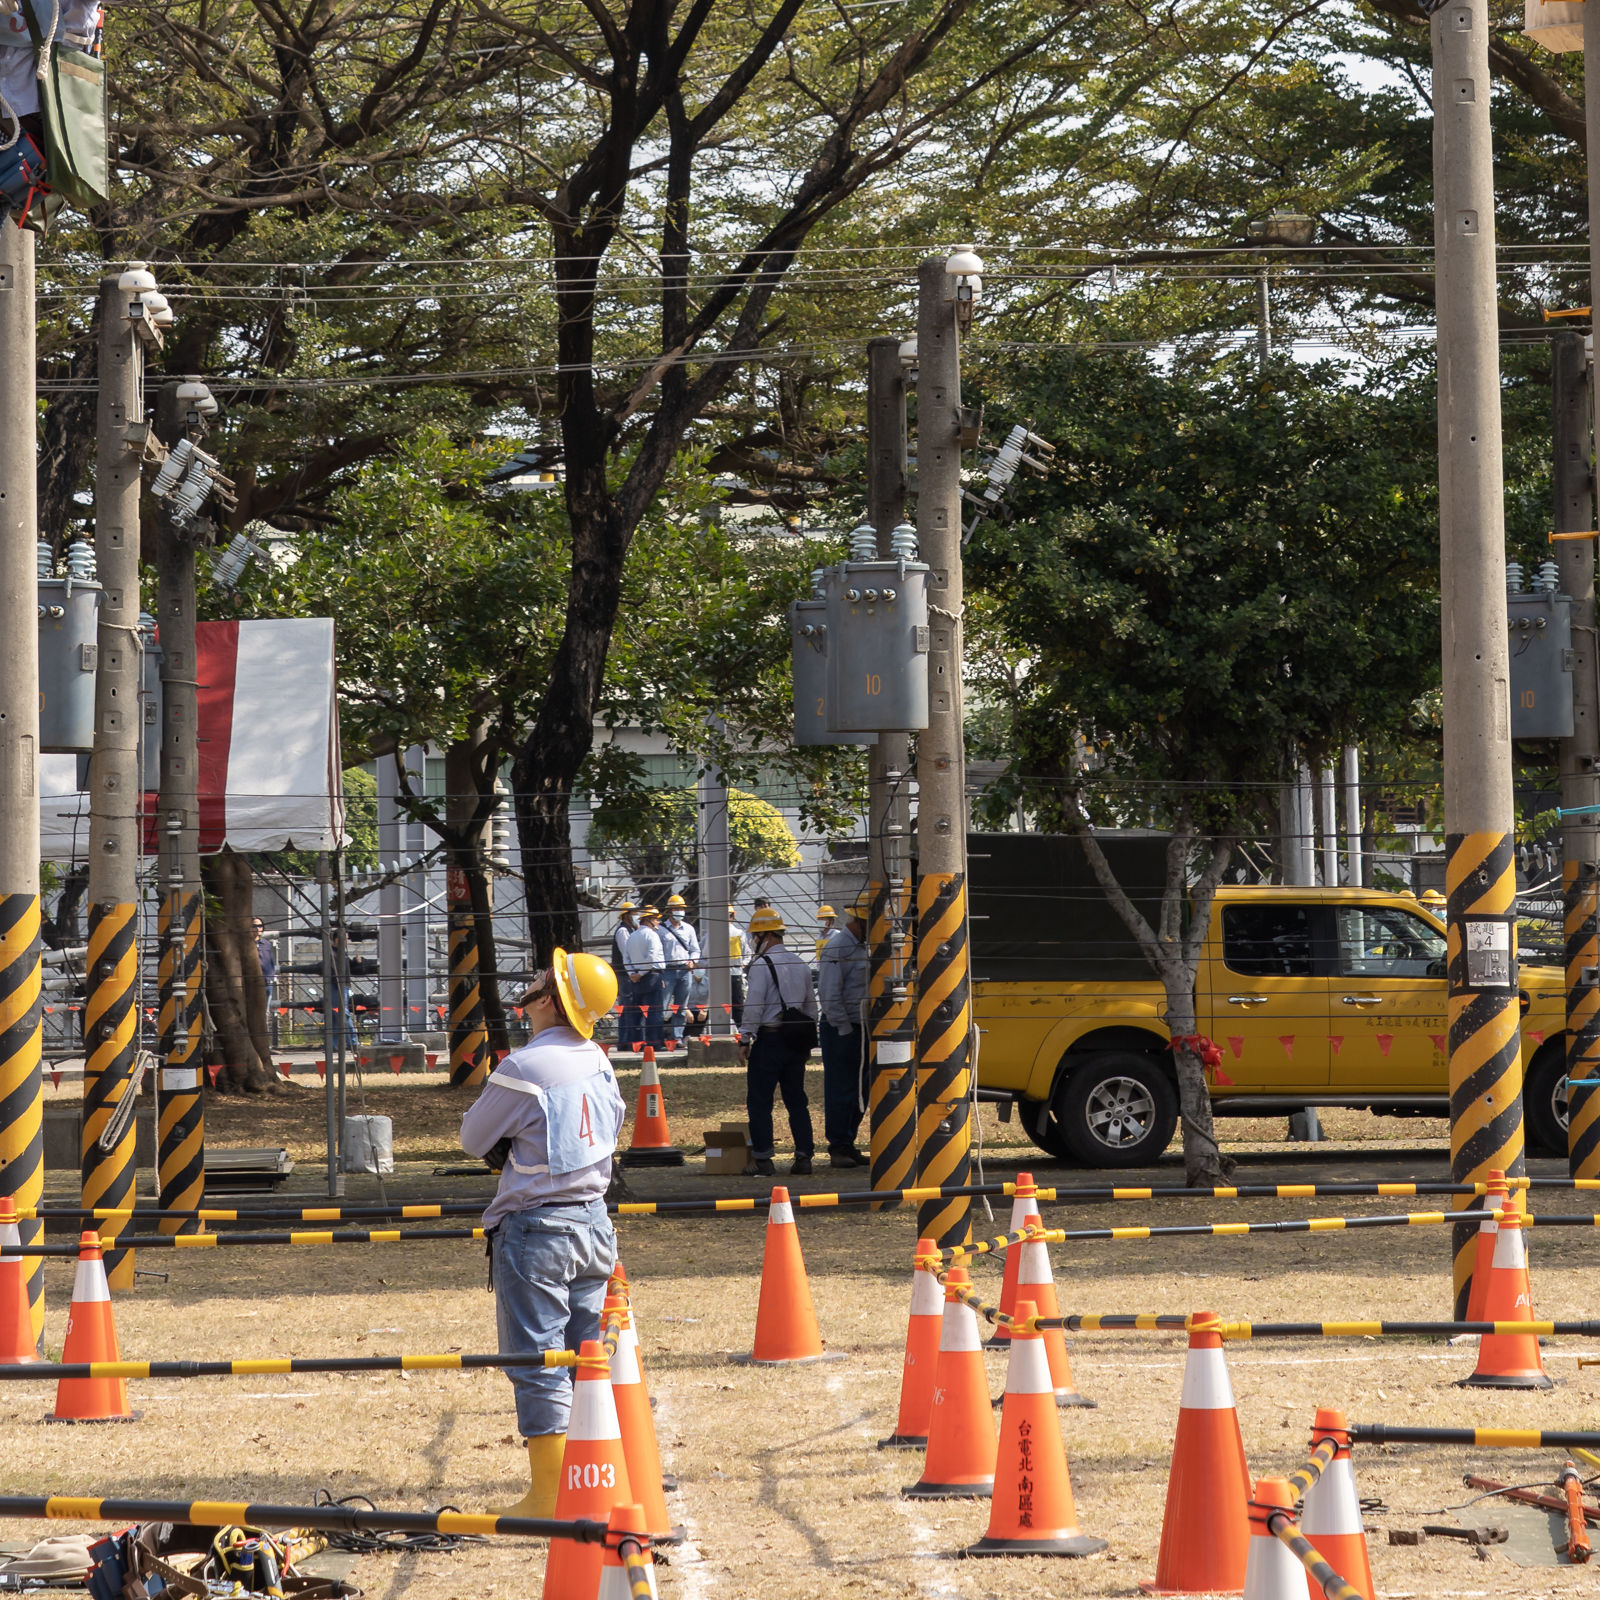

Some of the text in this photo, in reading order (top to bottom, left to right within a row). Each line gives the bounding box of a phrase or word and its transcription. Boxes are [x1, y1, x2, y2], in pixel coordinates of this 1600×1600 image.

[866, 673, 881, 696] 10
[1520, 690, 1535, 709] 10
[1484, 935, 1493, 948] 4
[579, 1092, 596, 1148] 4
[568, 1463, 616, 1490] R03
